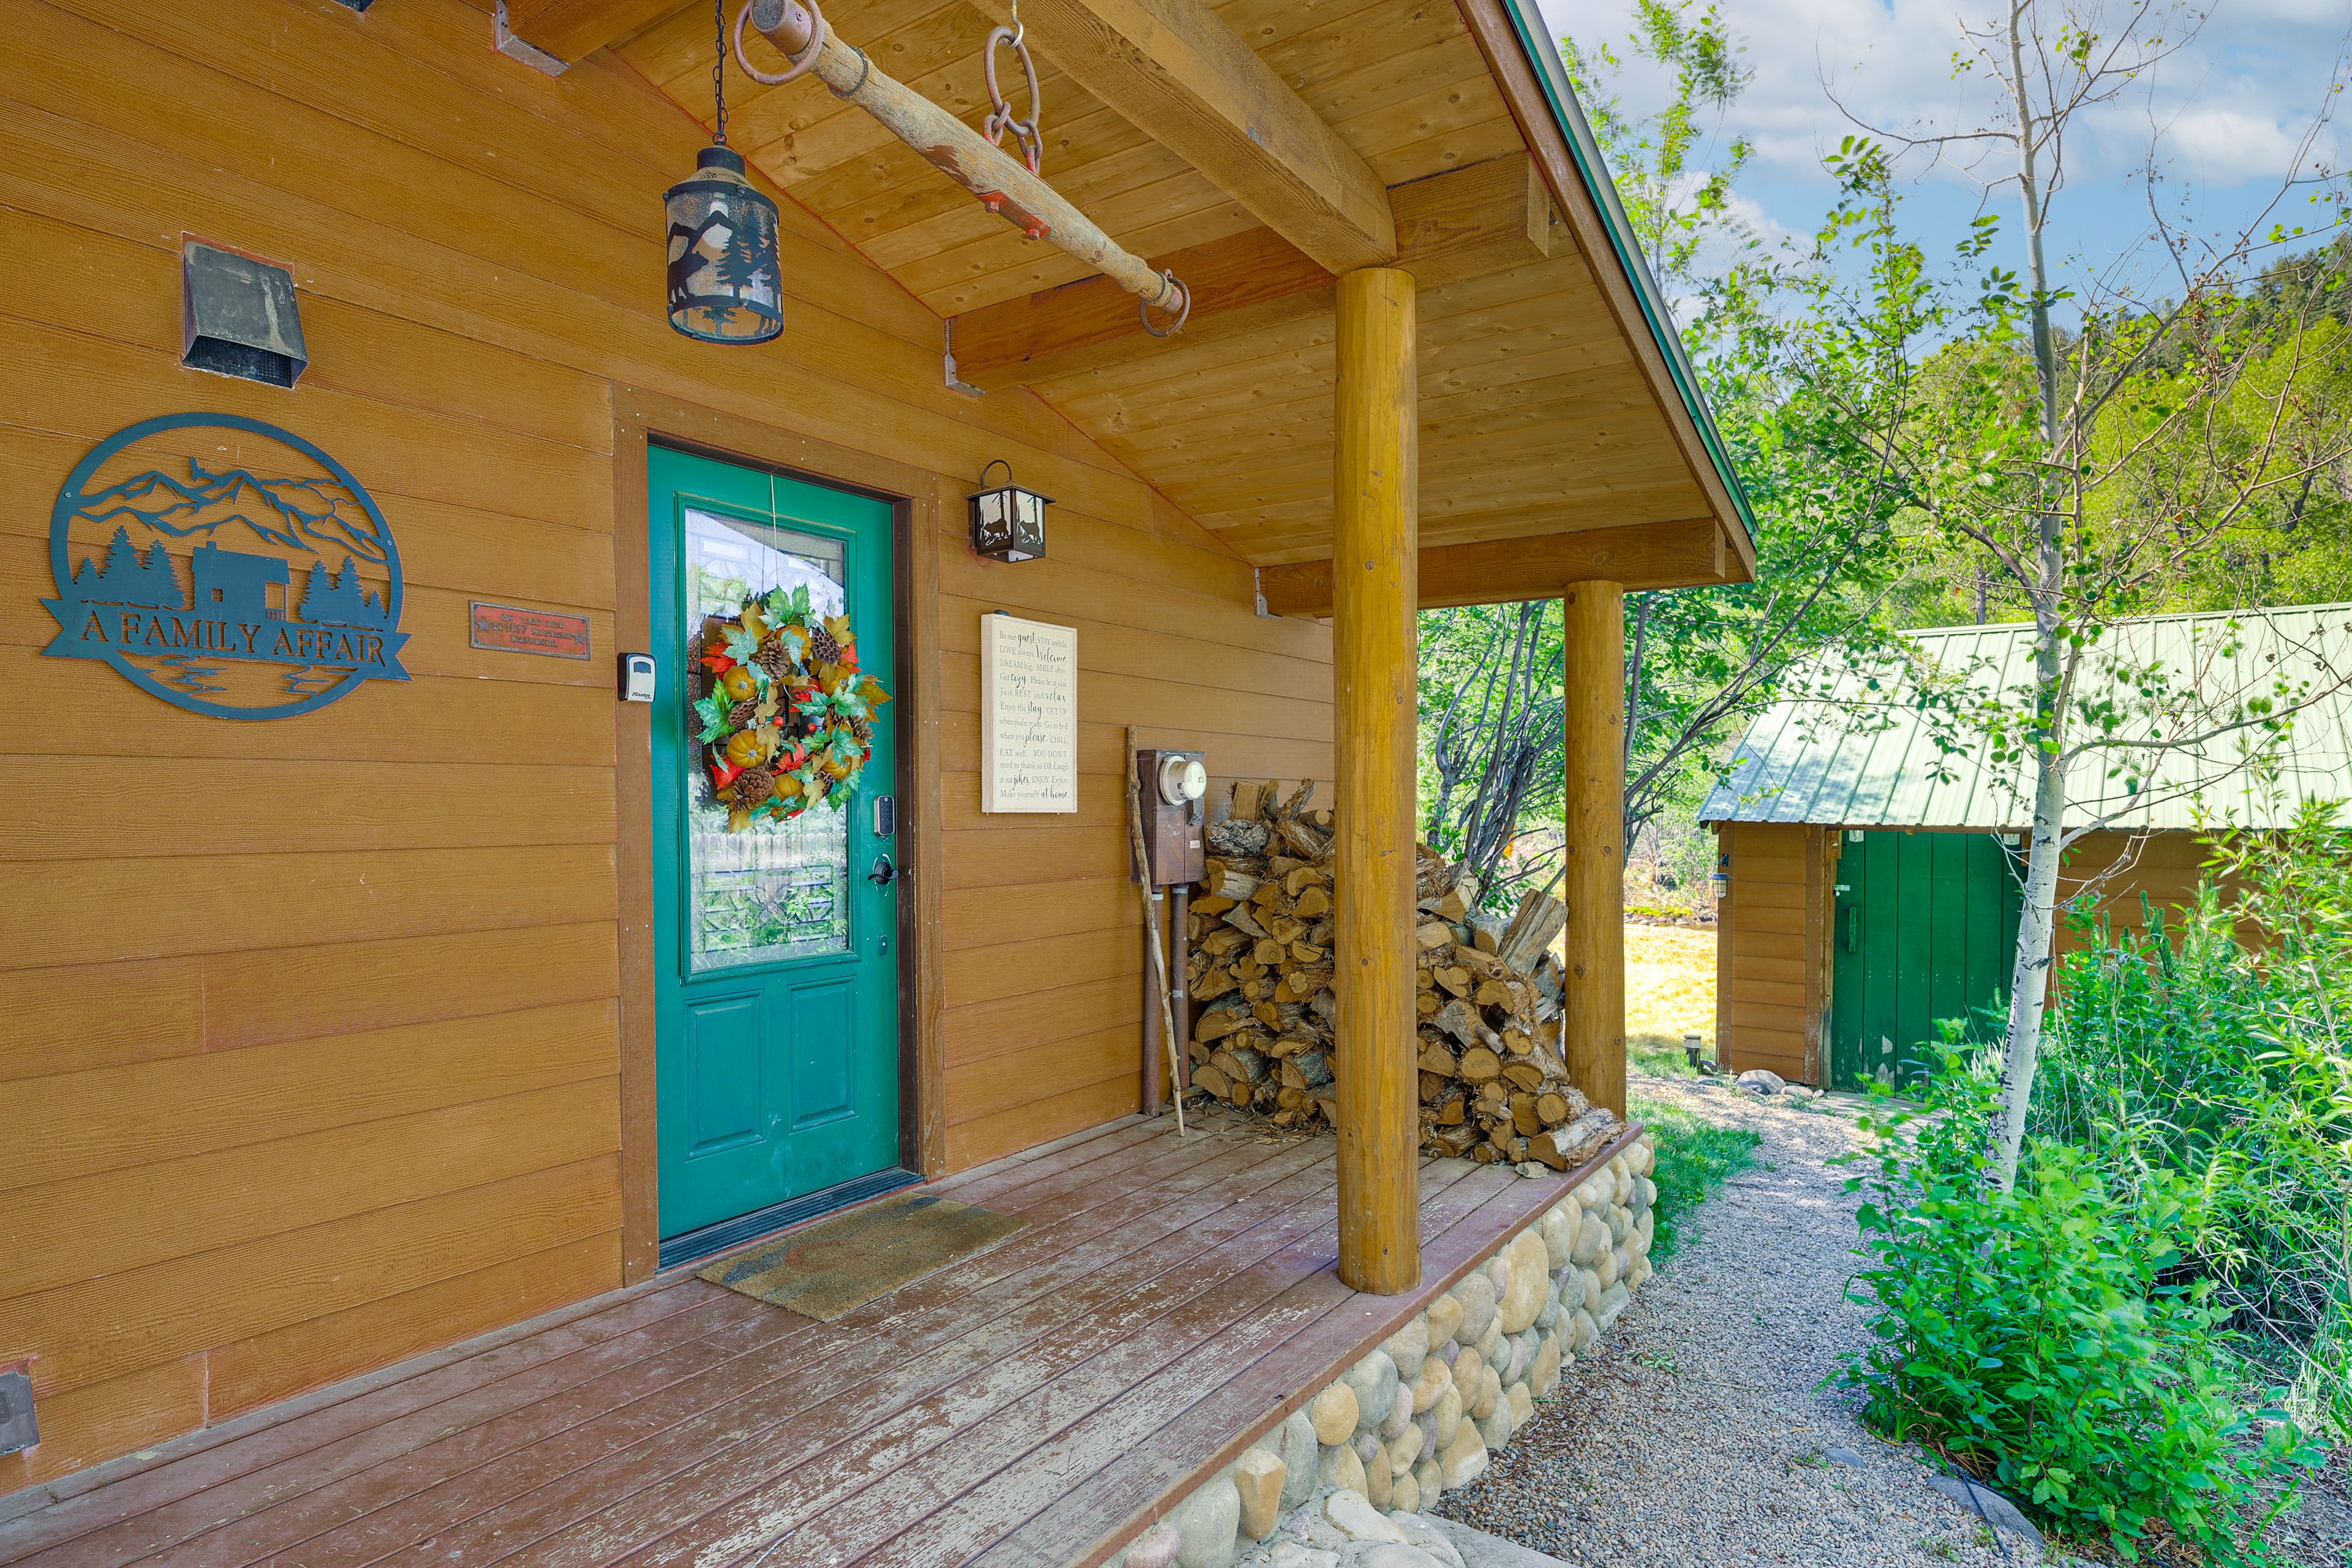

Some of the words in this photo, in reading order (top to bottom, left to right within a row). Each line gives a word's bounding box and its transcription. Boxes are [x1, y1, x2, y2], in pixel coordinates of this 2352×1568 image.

[80, 610, 110, 642] A
[118, 612, 262, 654] FAMILY
[271, 628, 386, 667] AFFAIR
[1000, 630, 1006, 639] Be
[1037, 636, 1051, 646] STAY
[1000, 645, 1017, 655] LOVE
[1000, 659, 1023, 669] DREAM
[1036, 663, 1054, 673] SMILE
[1000, 672, 1009, 680] Get
[1031, 676, 1045, 685] Please
[1000, 687, 1012, 697] Just
[1015, 689, 1031, 698] REST
[1000, 702, 1016, 713] Enjoy
[1046, 706, 1059, 715] GET
[1044, 720, 1053, 729] Go
[1000, 731, 1014, 740] when
[1000, 748, 1014, 756] EAT
[1033, 749, 1046, 758] YOU
[1000, 760, 1012, 769] need
[1021, 761, 1036, 769] thank
[1054, 761, 1069, 772] Laugh
[1000, 790, 1016, 798] Make
[1017, 790, 1040, 800] yourself
[1041, 787, 1048, 799] at
